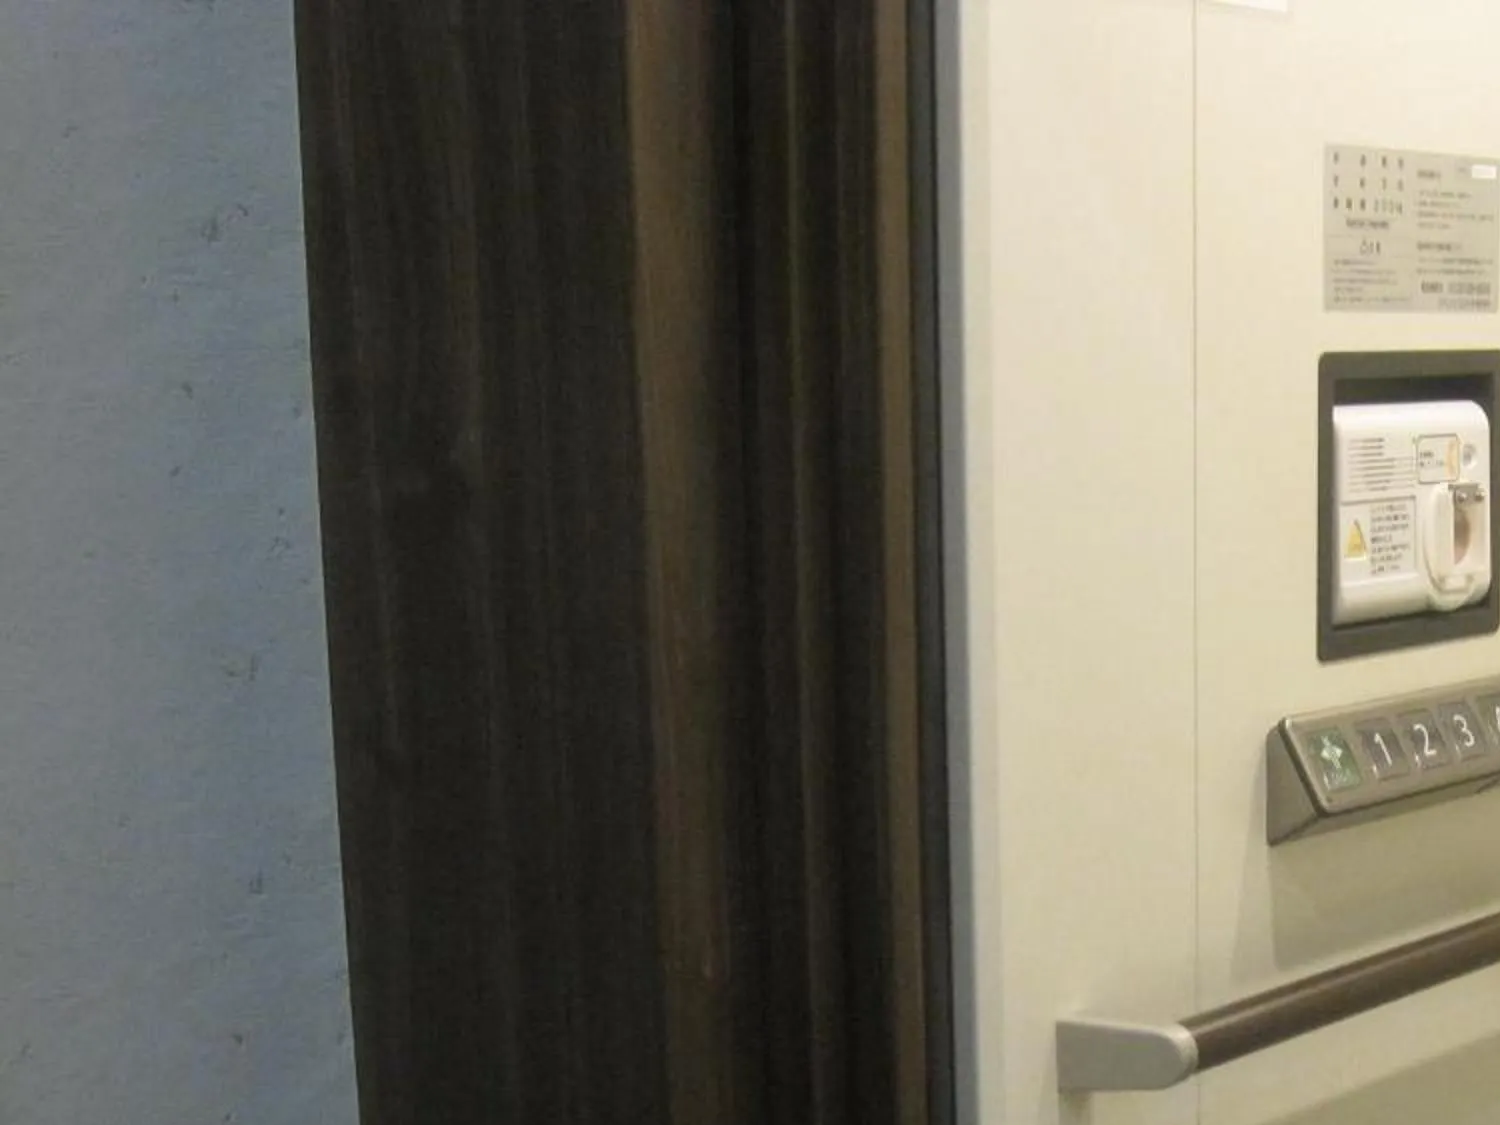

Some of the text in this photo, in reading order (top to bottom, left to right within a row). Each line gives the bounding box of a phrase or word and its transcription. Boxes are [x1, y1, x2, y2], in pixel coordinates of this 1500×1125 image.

[1373, 731, 1393, 768] 1
[1412, 722, 1438, 758] 2
[1452, 713, 1476, 748] 3
